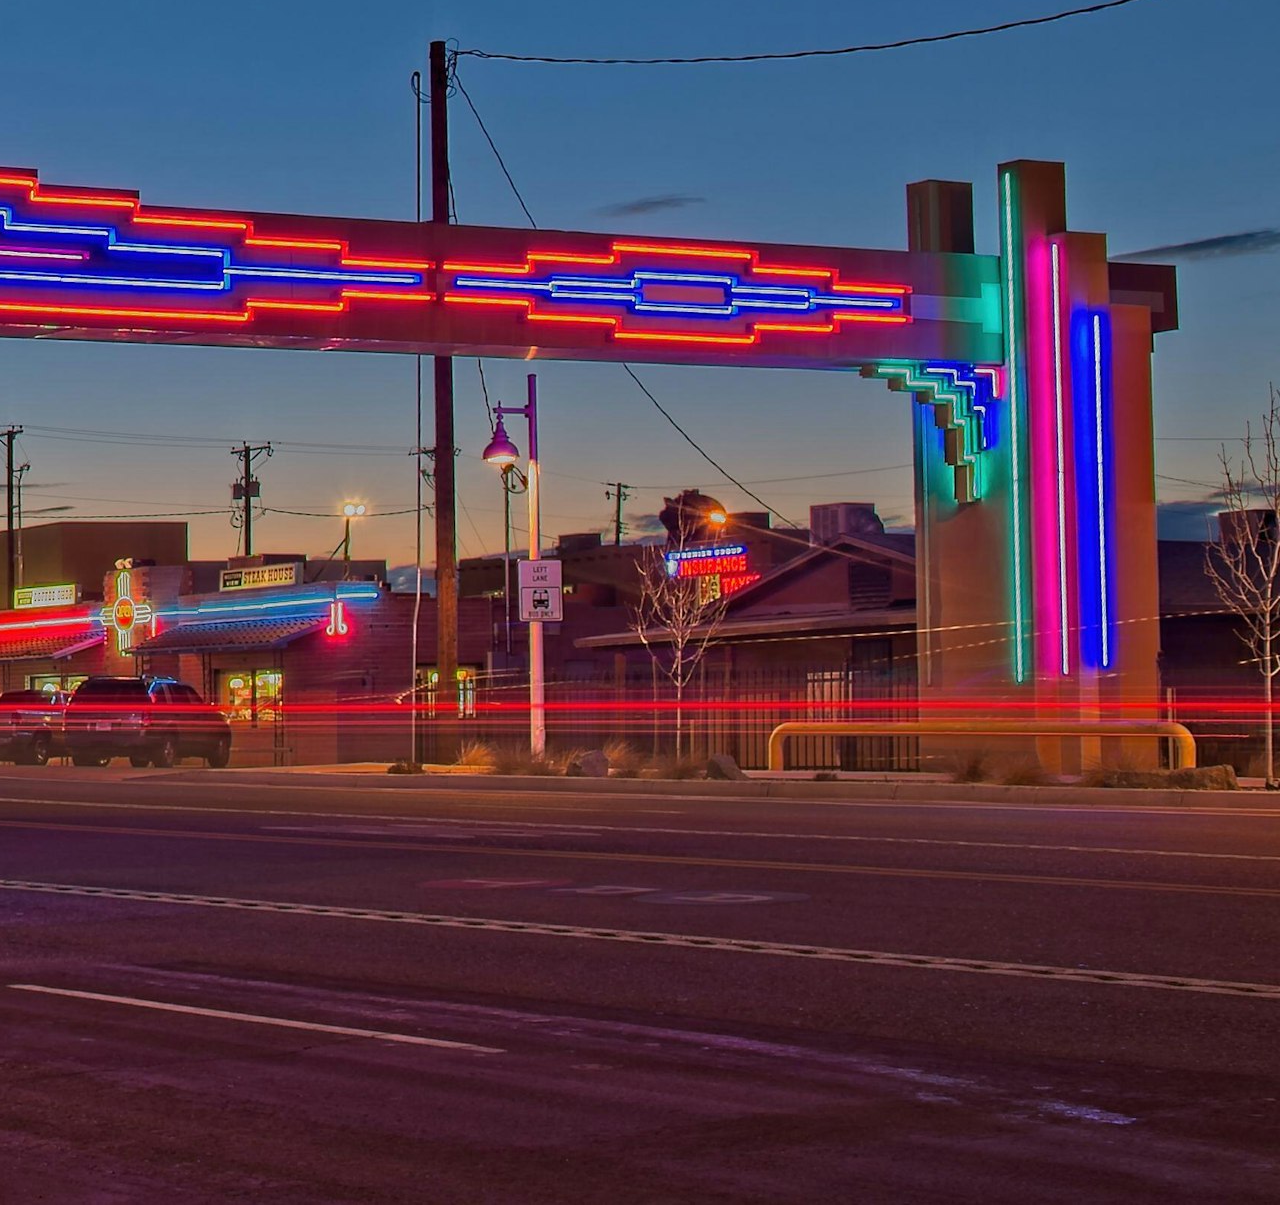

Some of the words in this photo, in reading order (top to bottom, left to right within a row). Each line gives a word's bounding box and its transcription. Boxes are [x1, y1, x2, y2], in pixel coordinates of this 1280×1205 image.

[679, 556, 747, 575] INSURANCE
[244, 570, 267, 584] STEAK
[268, 567, 293, 582] HOUSE
